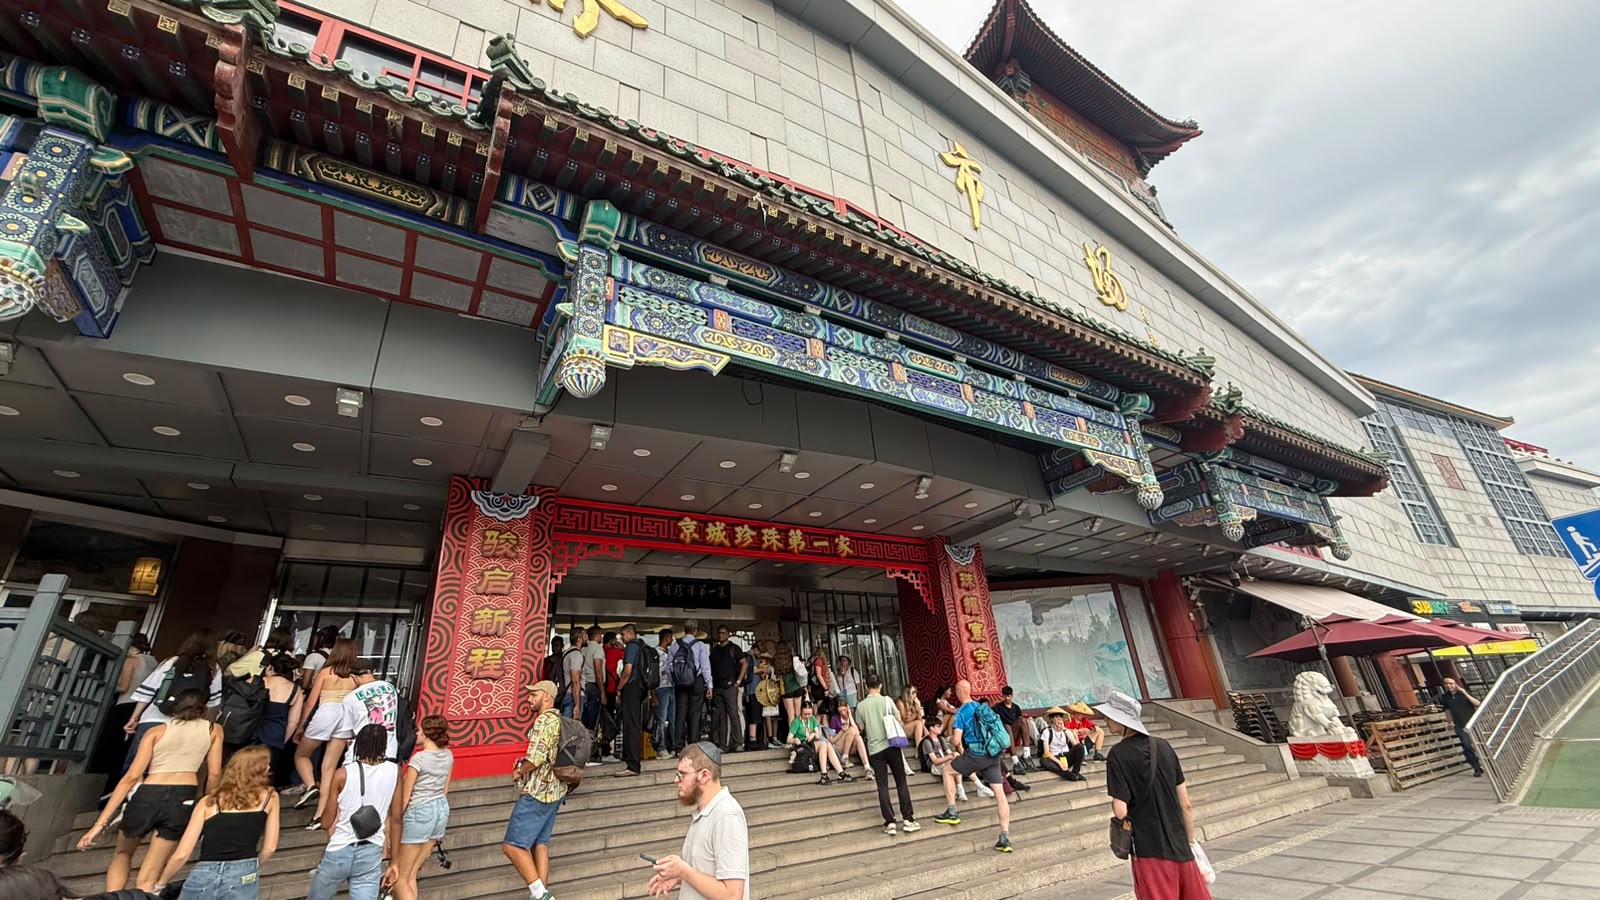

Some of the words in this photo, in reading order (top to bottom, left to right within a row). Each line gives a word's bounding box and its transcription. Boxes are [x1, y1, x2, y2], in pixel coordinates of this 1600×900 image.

[677, 516, 854, 558] 京城珍珠第一家
[466, 530, 518, 679] 骏启新程
[1412, 600, 1449, 614] SUBWAY
